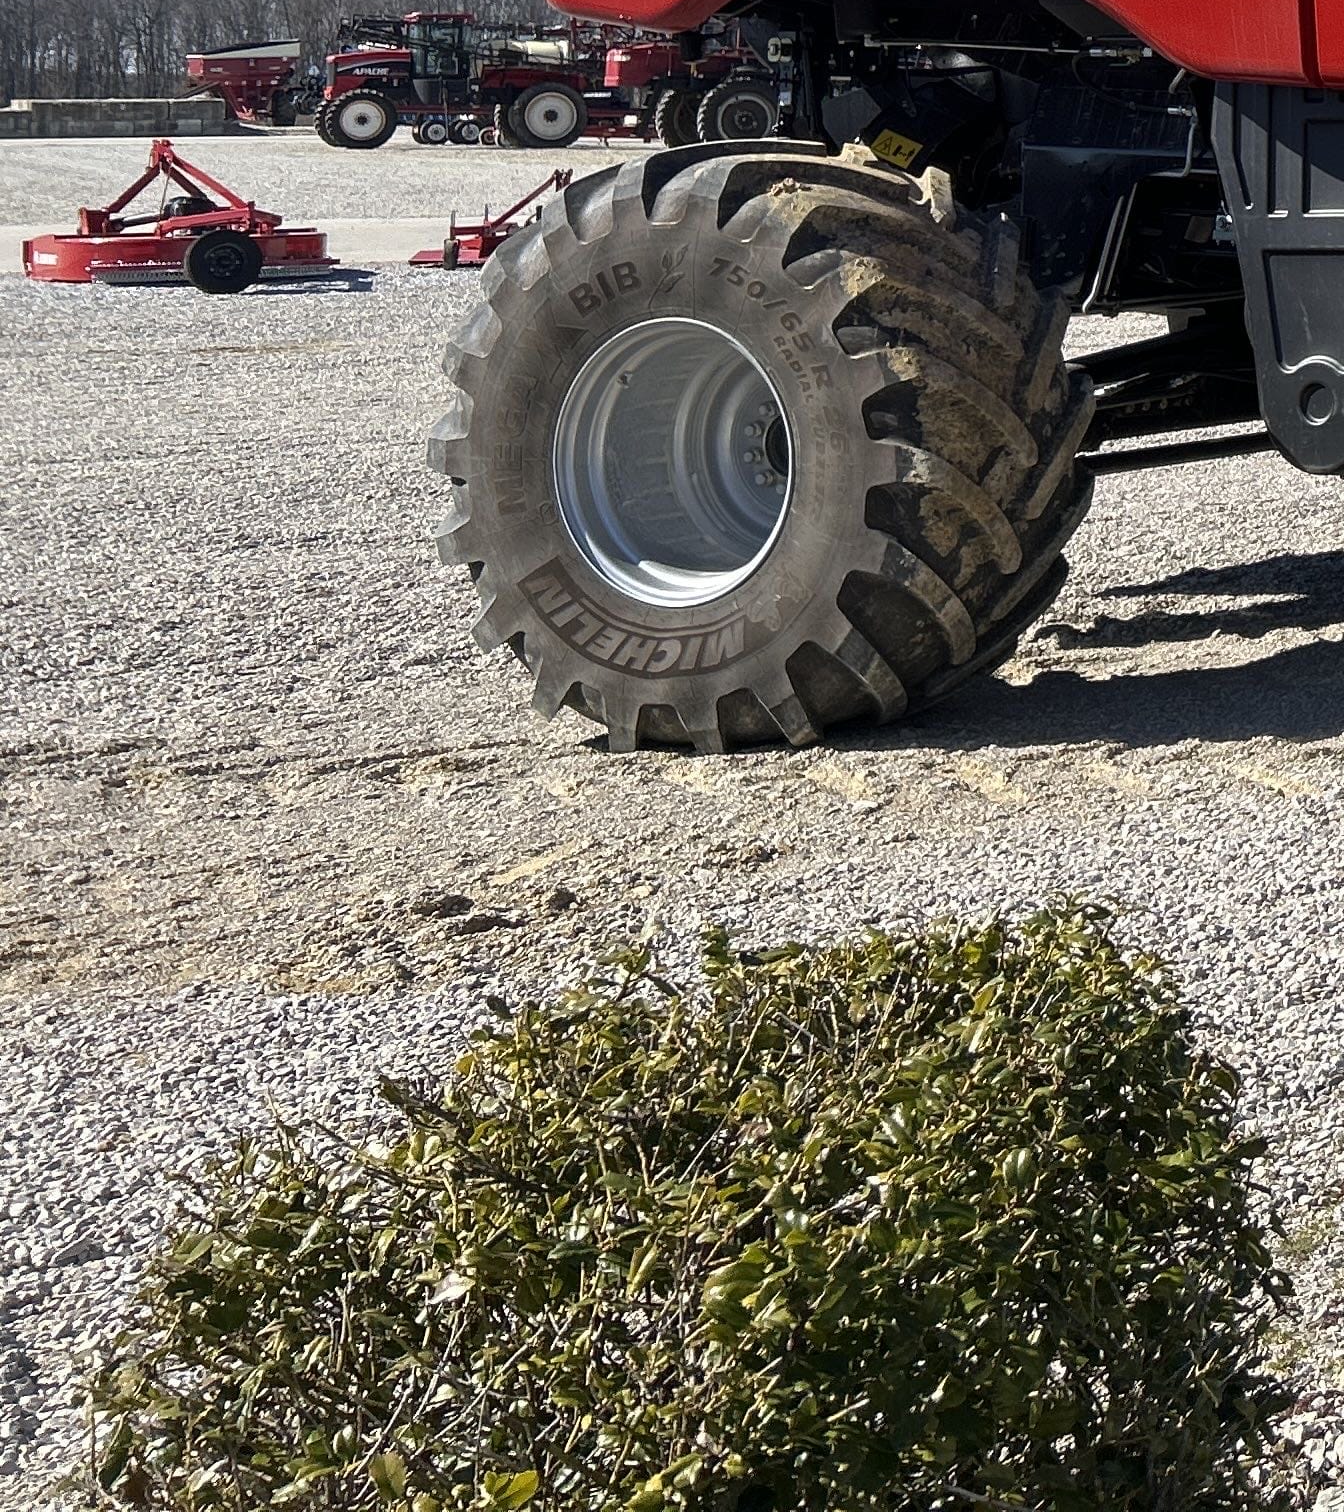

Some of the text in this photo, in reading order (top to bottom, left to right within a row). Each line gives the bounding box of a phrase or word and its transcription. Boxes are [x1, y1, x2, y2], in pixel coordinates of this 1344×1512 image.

[352, 67, 389, 76] APACHE
[568, 261, 642, 318] BIB
[709, 257, 815, 353] 750/65
[810, 364, 834, 391] R
[772, 335, 814, 403] RADIAL
[527, 575, 745, 673] MICHELIN
